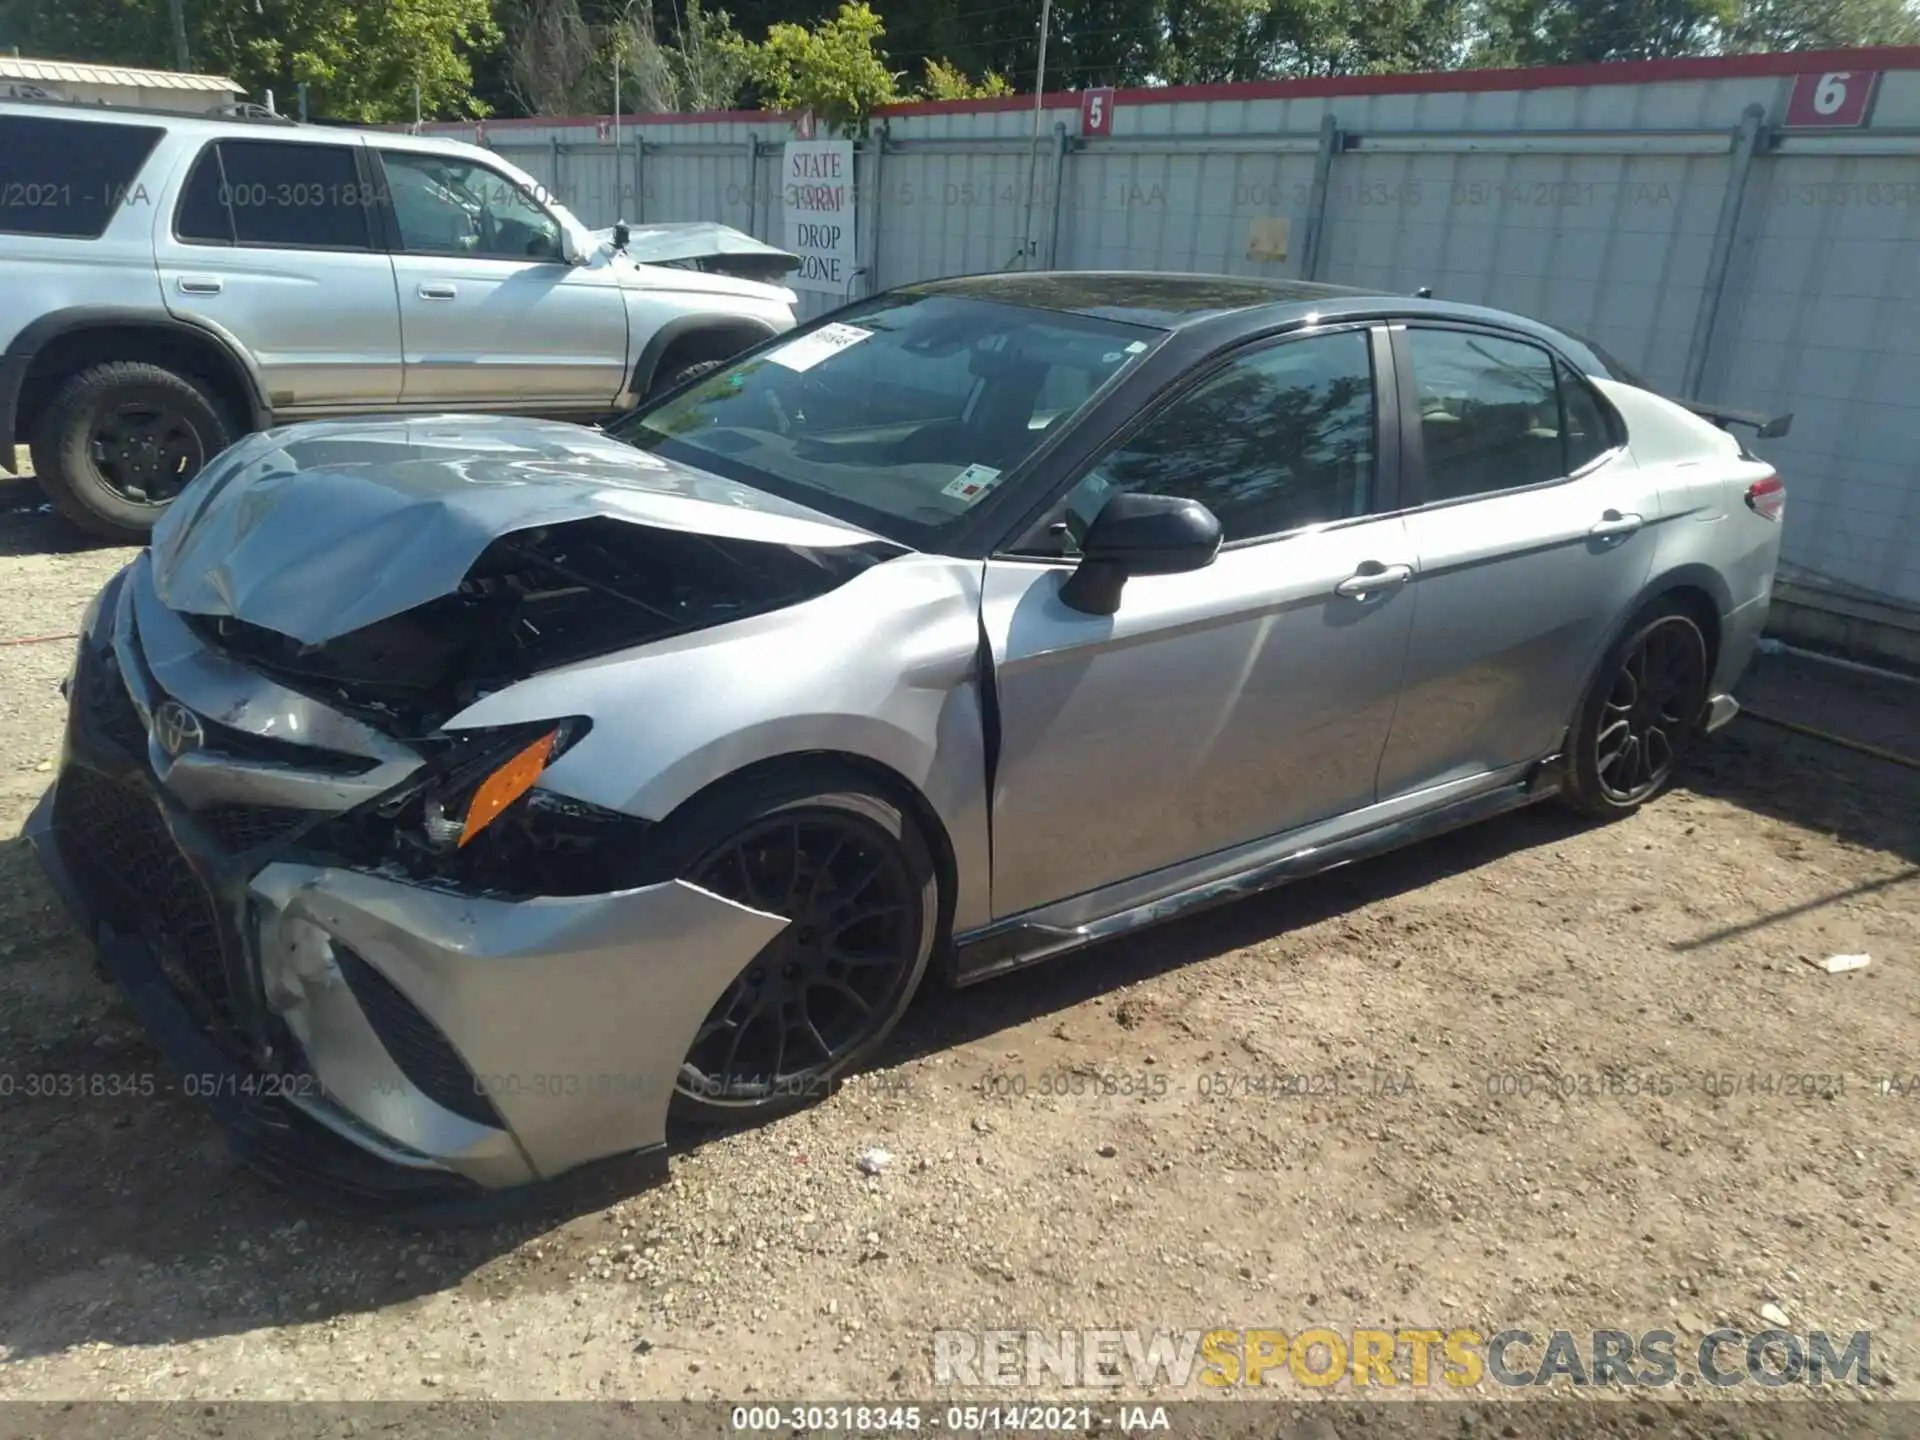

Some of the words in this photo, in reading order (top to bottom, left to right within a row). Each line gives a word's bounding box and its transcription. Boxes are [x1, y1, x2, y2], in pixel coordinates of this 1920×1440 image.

[1813, 72, 1850, 116] 6
[1089, 96, 1103, 129] 5
[792, 152, 842, 179] STATE
[795, 183, 842, 213] FARM
[797, 223, 842, 251] DROP
[797, 254, 842, 283] ZONE
